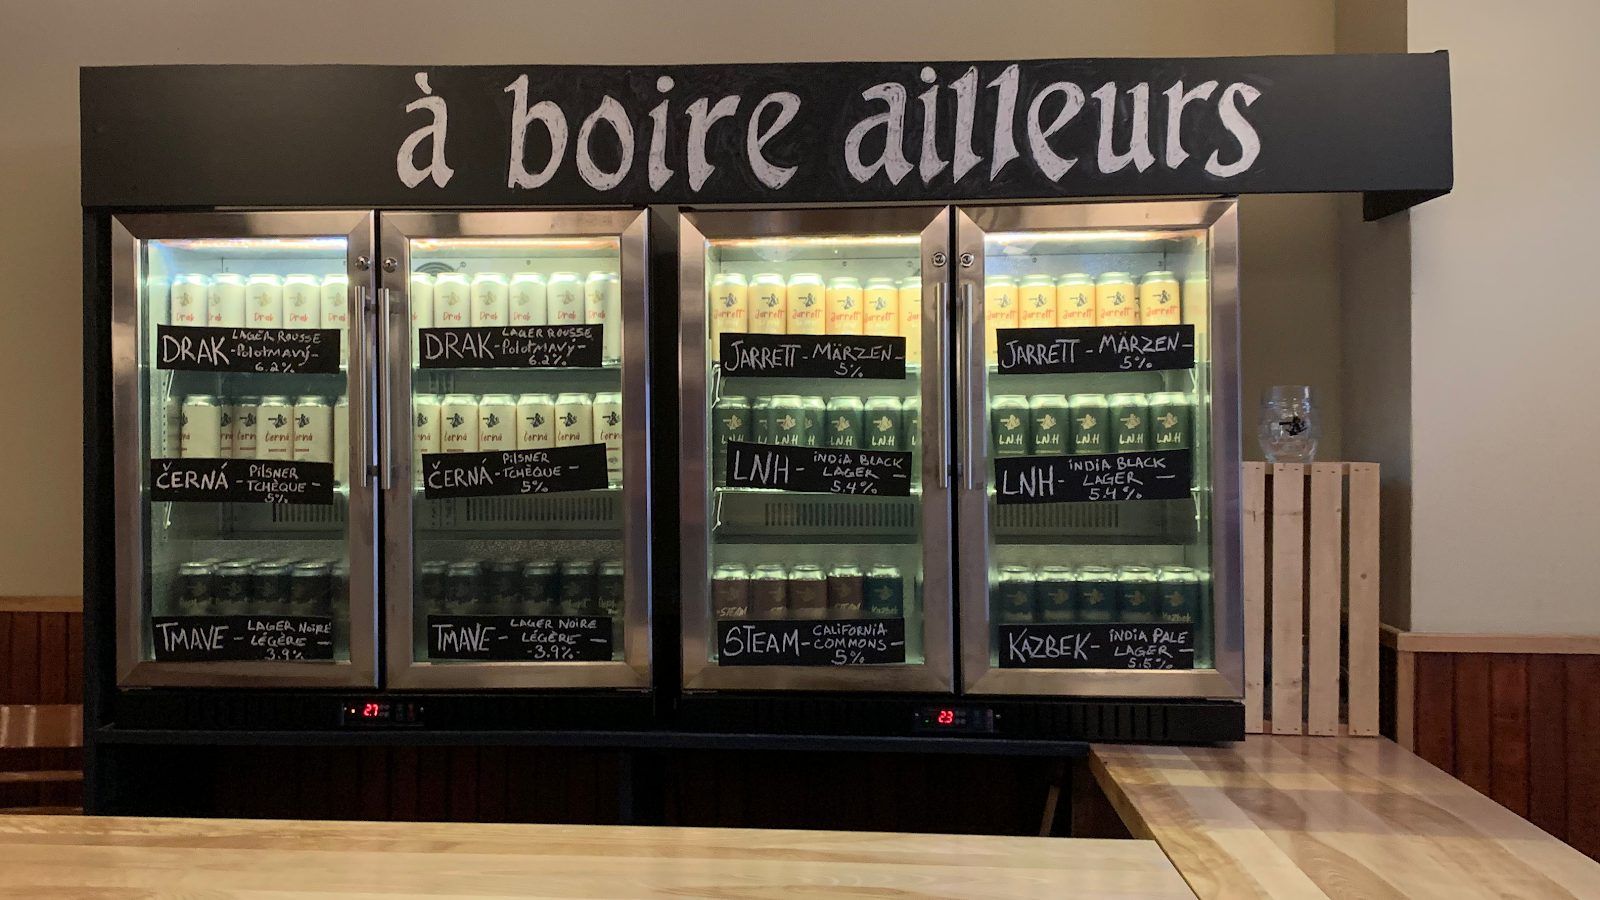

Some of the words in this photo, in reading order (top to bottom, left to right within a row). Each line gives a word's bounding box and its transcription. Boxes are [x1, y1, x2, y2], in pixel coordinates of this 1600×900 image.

[397, 72, 455, 188] à
[504, 74, 801, 193] boire
[844, 63, 1261, 186] ailleurs
[232, 329, 274, 341] LAGER
[277, 330, 321, 344] ROUSSE
[502, 327, 543, 339] LAGER
[547, 327, 593, 339] ROUSSE
[162, 334, 230, 366] DRAK
[425, 331, 494, 360] DRAK
[1002, 338, 1080, 369] JARRETT
[1099, 331, 1180, 355] MÄRZEN
[528, 353, 567, 366] 6.2%
[724, 340, 801, 371] JARRETT
[812, 343, 893, 361] MÄRZEN
[1119, 355, 1153, 370] 5%
[834, 362, 864, 378] 5%
[733, 450, 789, 485] LNH
[860, 453, 904, 469] BLACK
[1117, 457, 1166, 470] BLACK
[156, 462, 229, 490] ČERNÁ
[428, 457, 494, 490] ČERNÁ
[823, 467, 880, 480] LAGER
[1003, 465, 1054, 498] LNH
[1082, 471, 1144, 487] LAGER
[520, 479, 549, 493] 5%
[830, 481, 878, 495] 5.4%
[1088, 486, 1143, 501] 5.4%
[264, 493, 289, 504] 5%
[247, 620, 296, 632] LAGER
[510, 618, 553, 629] LAGER
[156, 622, 229, 652] TMAVE
[250, 631, 307, 647] LÉGÈRE
[432, 623, 496, 653] TMAVE
[521, 630, 581, 645] LÉGÈRE
[723, 625, 800, 657] STEAM
[1153, 627, 1188, 644] PALE
[813, 638, 887, 651] COMMONS
[1009, 628, 1091, 663] KAZBEK
[1114, 645, 1173, 658] LAGER
[831, 649, 865, 665] 5%
